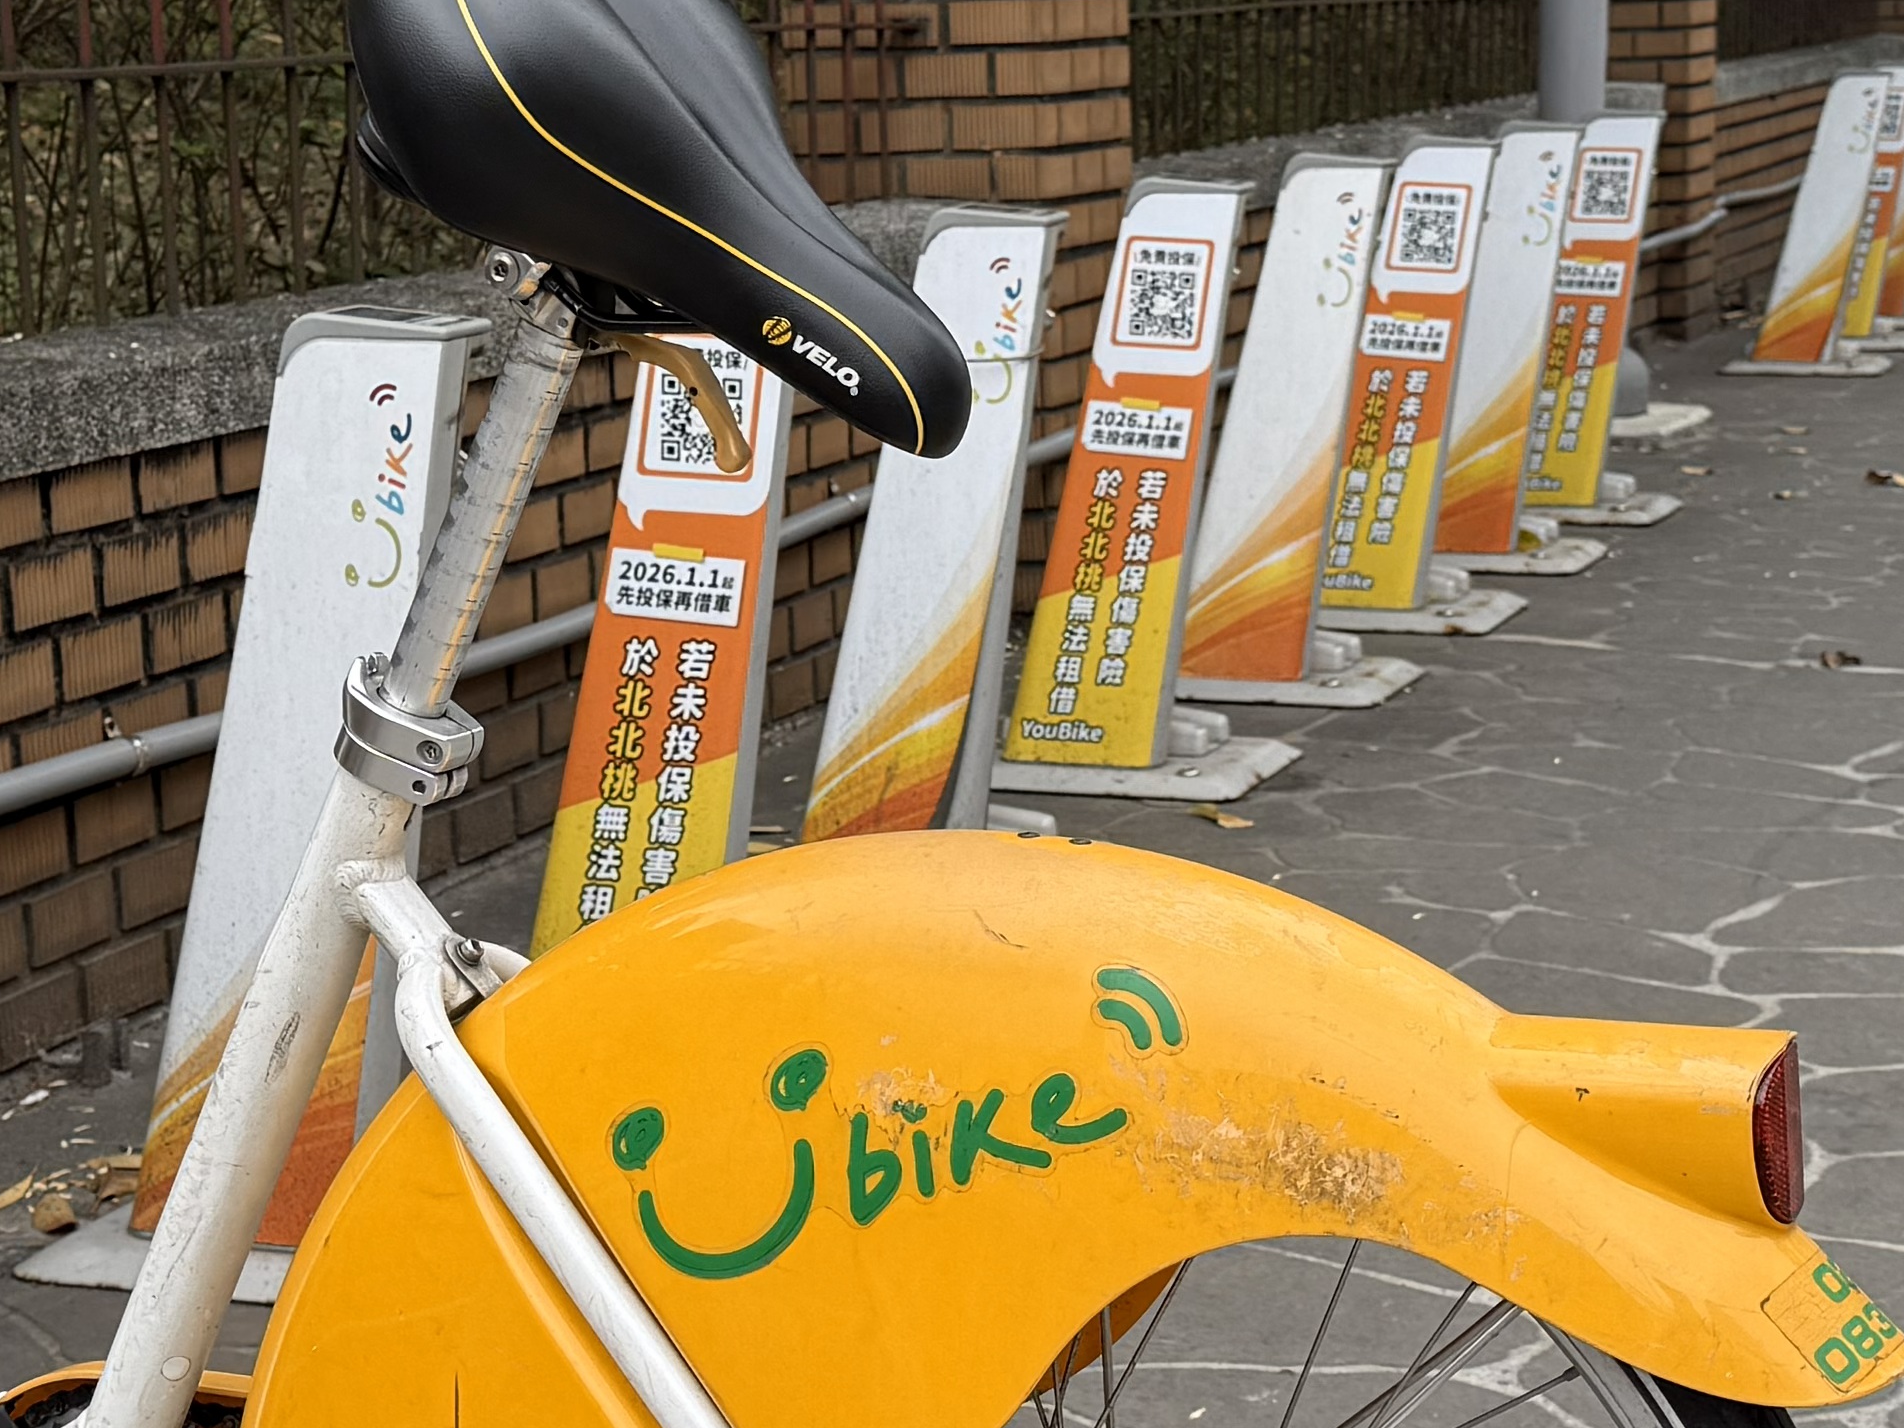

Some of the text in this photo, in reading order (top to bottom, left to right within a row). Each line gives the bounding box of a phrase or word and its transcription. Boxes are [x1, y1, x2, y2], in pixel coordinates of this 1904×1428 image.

[707, 349, 742, 369] 投保
[792, 334, 860, 387] VELO
[618, 560, 735, 590] 2026.1.1起
[1049, 468, 1123, 714] 於北北桃無法租借
[1097, 470, 1167, 686] 若未投保傷害險
[1323, 571, 1372, 591] uBike
[617, 585, 732, 613] 先投保再借車
[1021, 719, 1103, 742] YouBike
[579, 637, 660, 923] 於北北桃無法租
[639, 639, 716, 898] 若未投保傷害
